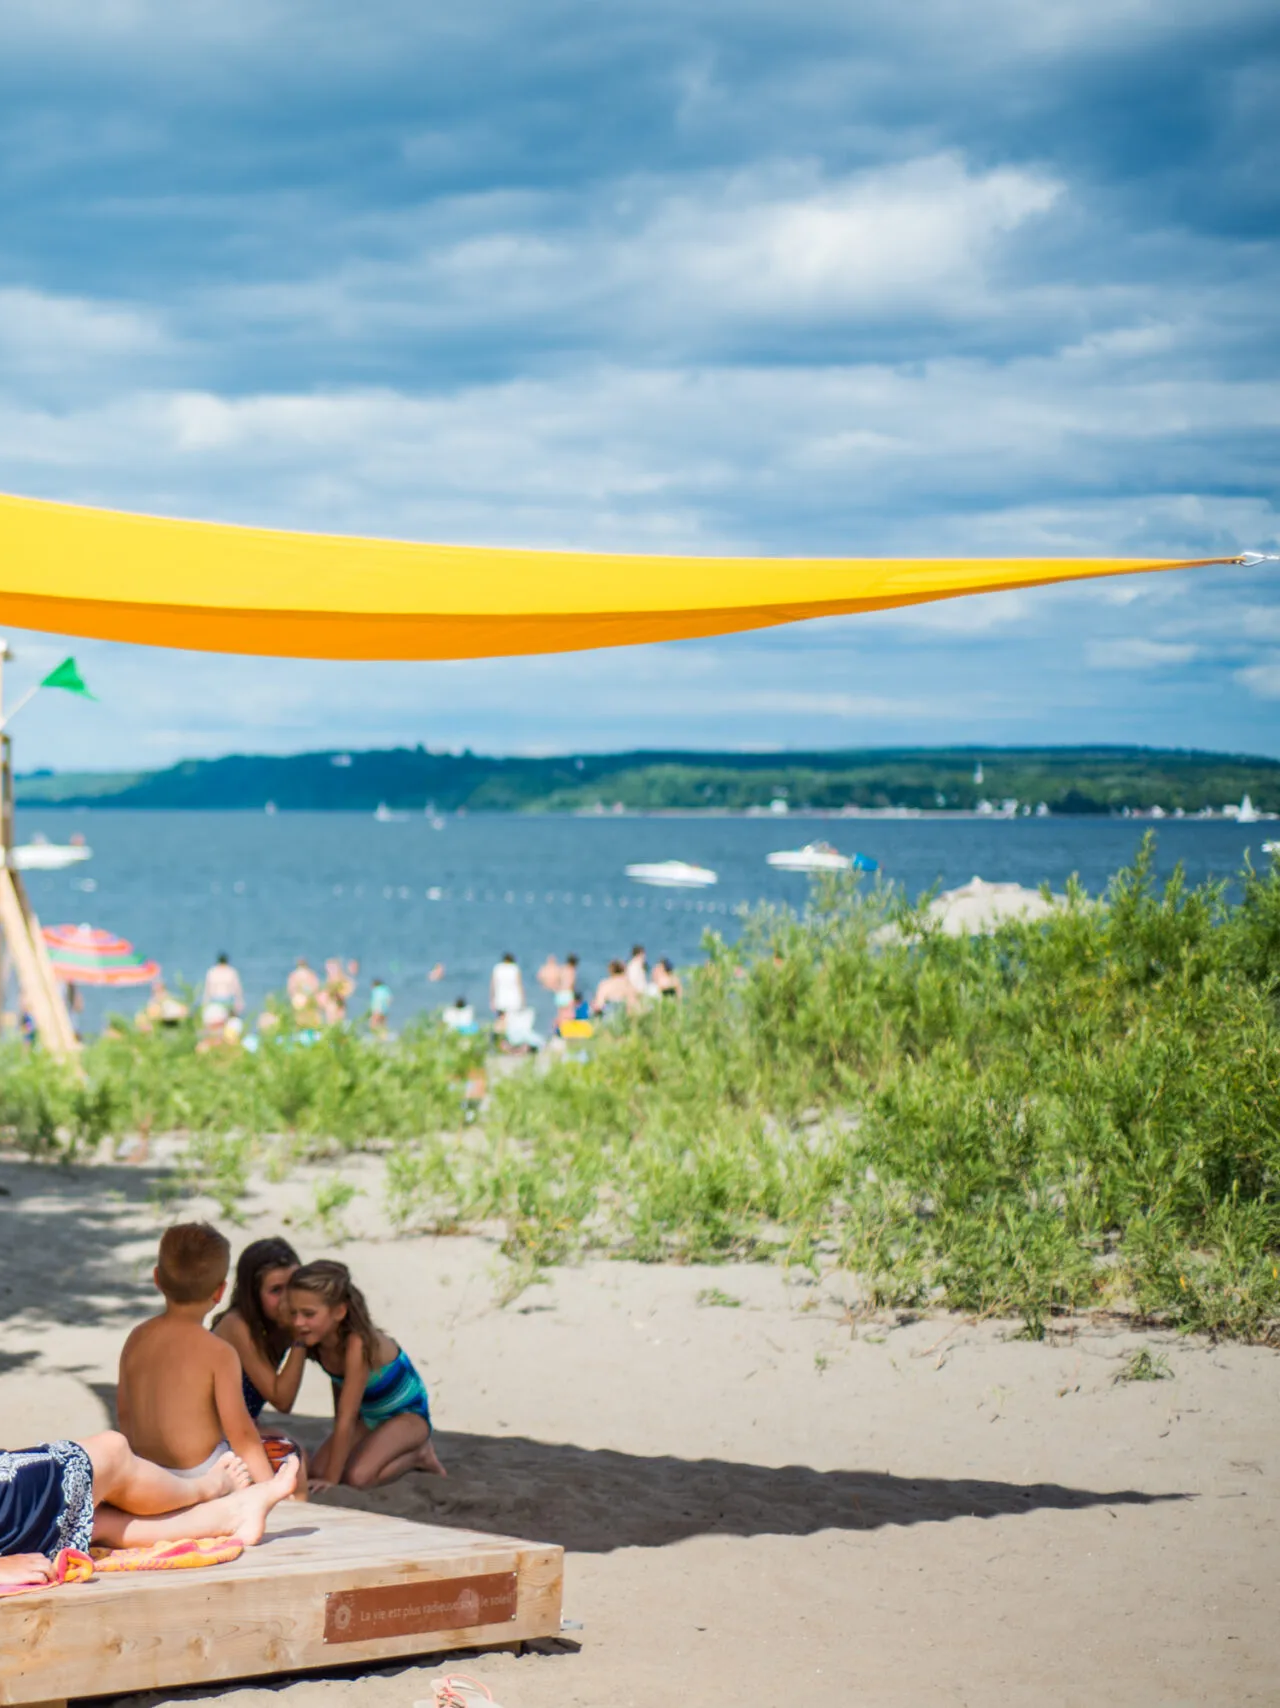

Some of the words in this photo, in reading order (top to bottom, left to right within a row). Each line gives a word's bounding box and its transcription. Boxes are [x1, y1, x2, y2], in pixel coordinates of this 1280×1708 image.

[360, 1610, 371, 1622] La
[373, 1608, 386, 1620] vie
[388, 1606, 401, 1618] est
[403, 1603, 421, 1620] plus
